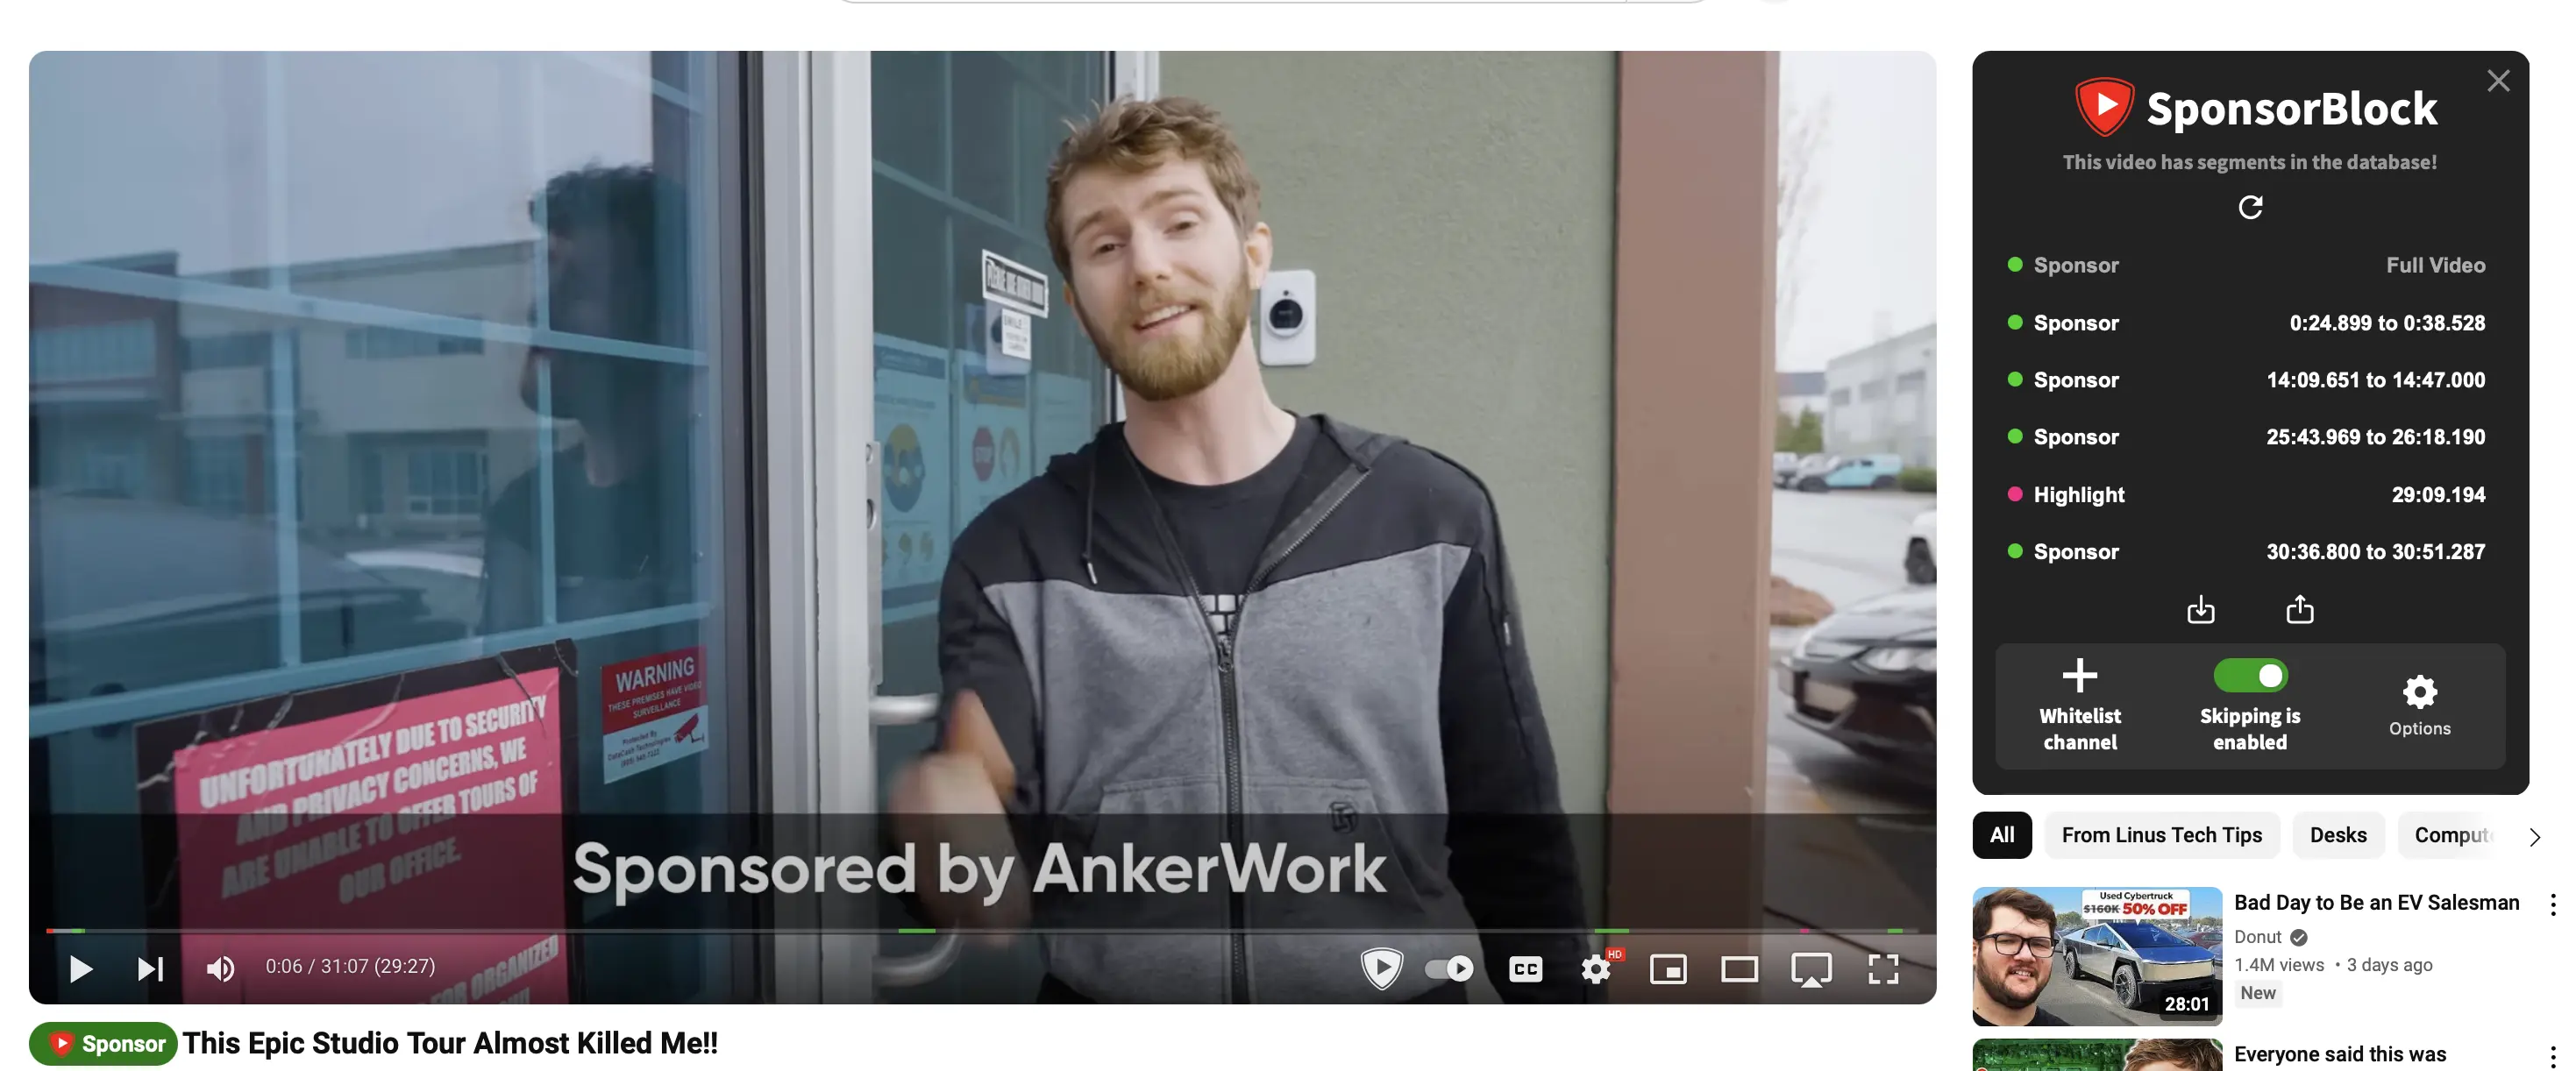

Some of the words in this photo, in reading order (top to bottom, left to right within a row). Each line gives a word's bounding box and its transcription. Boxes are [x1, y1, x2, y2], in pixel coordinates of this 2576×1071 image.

[2147, 90, 2438, 133] SponsorBlock
[2063, 153, 2102, 169] This
[2106, 153, 2156, 169] video
[2162, 154, 2193, 169] has
[2197, 156, 2286, 174] segments
[2291, 153, 2307, 169] in
[2312, 154, 2342, 169] the
[2347, 154, 2437, 169] database!
[2035, 257, 2119, 277] Sponsor
[2387, 257, 2423, 273] Full
[2430, 257, 2486, 273] Video
[2034, 315, 2120, 335] Sponsor
[2290, 315, 2372, 331] 0:24.899
[2378, 315, 2398, 331] to
[2404, 315, 2486, 331] 0:38.528
[2034, 372, 2120, 392] Sponsor
[2268, 372, 2358, 388] 14:09.651
[2366, 372, 2386, 388] to
[2394, 372, 2486, 388] 14:47.000
[2034, 429, 2120, 449] Sponsor
[2267, 429, 2360, 445] 25:43.969
[2366, 429, 2386, 445] to
[2393, 429, 2486, 445] 26:18.190
[2035, 486, 2125, 507] Highlight
[2393, 486, 2486, 503] 29:09.194
[2034, 543, 2120, 564] Sponsor
[2267, 543, 2360, 560] 30:36.800
[2366, 544, 2386, 560] to
[2393, 543, 2486, 560] 30:51.287
[616, 656, 694, 693] WARNING
[608, 702, 631, 713] THESE
[632, 690, 665, 706] PREMISES
[666, 684, 684, 697] HAVE
[684, 680, 702, 692] VIDEO
[633, 699, 681, 719] SURVEILLANCE
[2039, 707, 2122, 723] Whitelist
[2201, 707, 2281, 727] Skipping
[2287, 707, 2301, 723] is
[2390, 721, 2451, 737] Options
[199, 732, 393, 809] UNFORTUNATELY
[396, 722, 436, 755] DUE
[438, 716, 462, 743] TO
[466, 694, 547, 738] SECURITY
[2044, 734, 2117, 749] channel
[2214, 734, 2287, 750] enabled
[236, 802, 289, 846] AND
[292, 771, 390, 827] PRIVACY
[394, 745, 498, 793] CONCERNS,
[500, 736, 527, 765] WE
[222, 855, 270, 899] ARE
[274, 823, 362, 879] UNABLE
[366, 812, 395, 846] TO
[397, 793, 456, 834] OFFER
[459, 777, 516, 814] TOURS
[518, 770, 538, 798] OF
[1990, 826, 2014, 842] All
[2063, 827, 2110, 842] From
[2117, 826, 2166, 842] Linus
[2172, 826, 2217, 843] Tech
[2223, 826, 2262, 847] Tips
[2311, 826, 2367, 842] Desks
[339, 864, 387, 904] OUR
[389, 836, 463, 886] OFFICE.
[2124, 892, 2173, 901] Cybertruck
[2236, 894, 2270, 910] Bad
[2277, 894, 2311, 914] Day
[2316, 896, 2334, 910] to
[2341, 894, 2364, 910] Be
[2370, 898, 2392, 911] an
[2399, 894, 2423, 910] EV
[2429, 894, 2519, 911] Salesman
[2123, 903, 2155, 915] 50%
[2158, 904, 2187, 915] OFF
[2236, 930, 2281, 943] Donut
[1608, 950, 1622, 959] HD
[2236, 958, 2274, 971] 1.4M
[2280, 958, 2324, 971] views
[266, 957, 303, 975] 0:06
[308, 956, 315, 978] /
[321, 957, 369, 975] 31:07
[374, 956, 436, 978] (29:27)
[471, 933, 559, 1001] ORGANIZED
[2348, 958, 2356, 971] 3
[2362, 957, 2398, 975] days
[2404, 961, 2432, 975] ago
[2242, 986, 2276, 999] New
[83, 1035, 166, 1056] Sponsor
[182, 1031, 240, 1054] This
[250, 1031, 304, 1060] Epic
[313, 1031, 399, 1054] Studio
[407, 1032, 466, 1054] Tour
[473, 1031, 569, 1054] Almost
[579, 1031, 651, 1054] Killed
[662, 1032, 717, 1054] Me!!
[2236, 1046, 2319, 1066] Everyone
[2325, 1046, 2363, 1061] said
[2369, 1046, 2403, 1061] this
[2409, 1050, 2446, 1061] was
